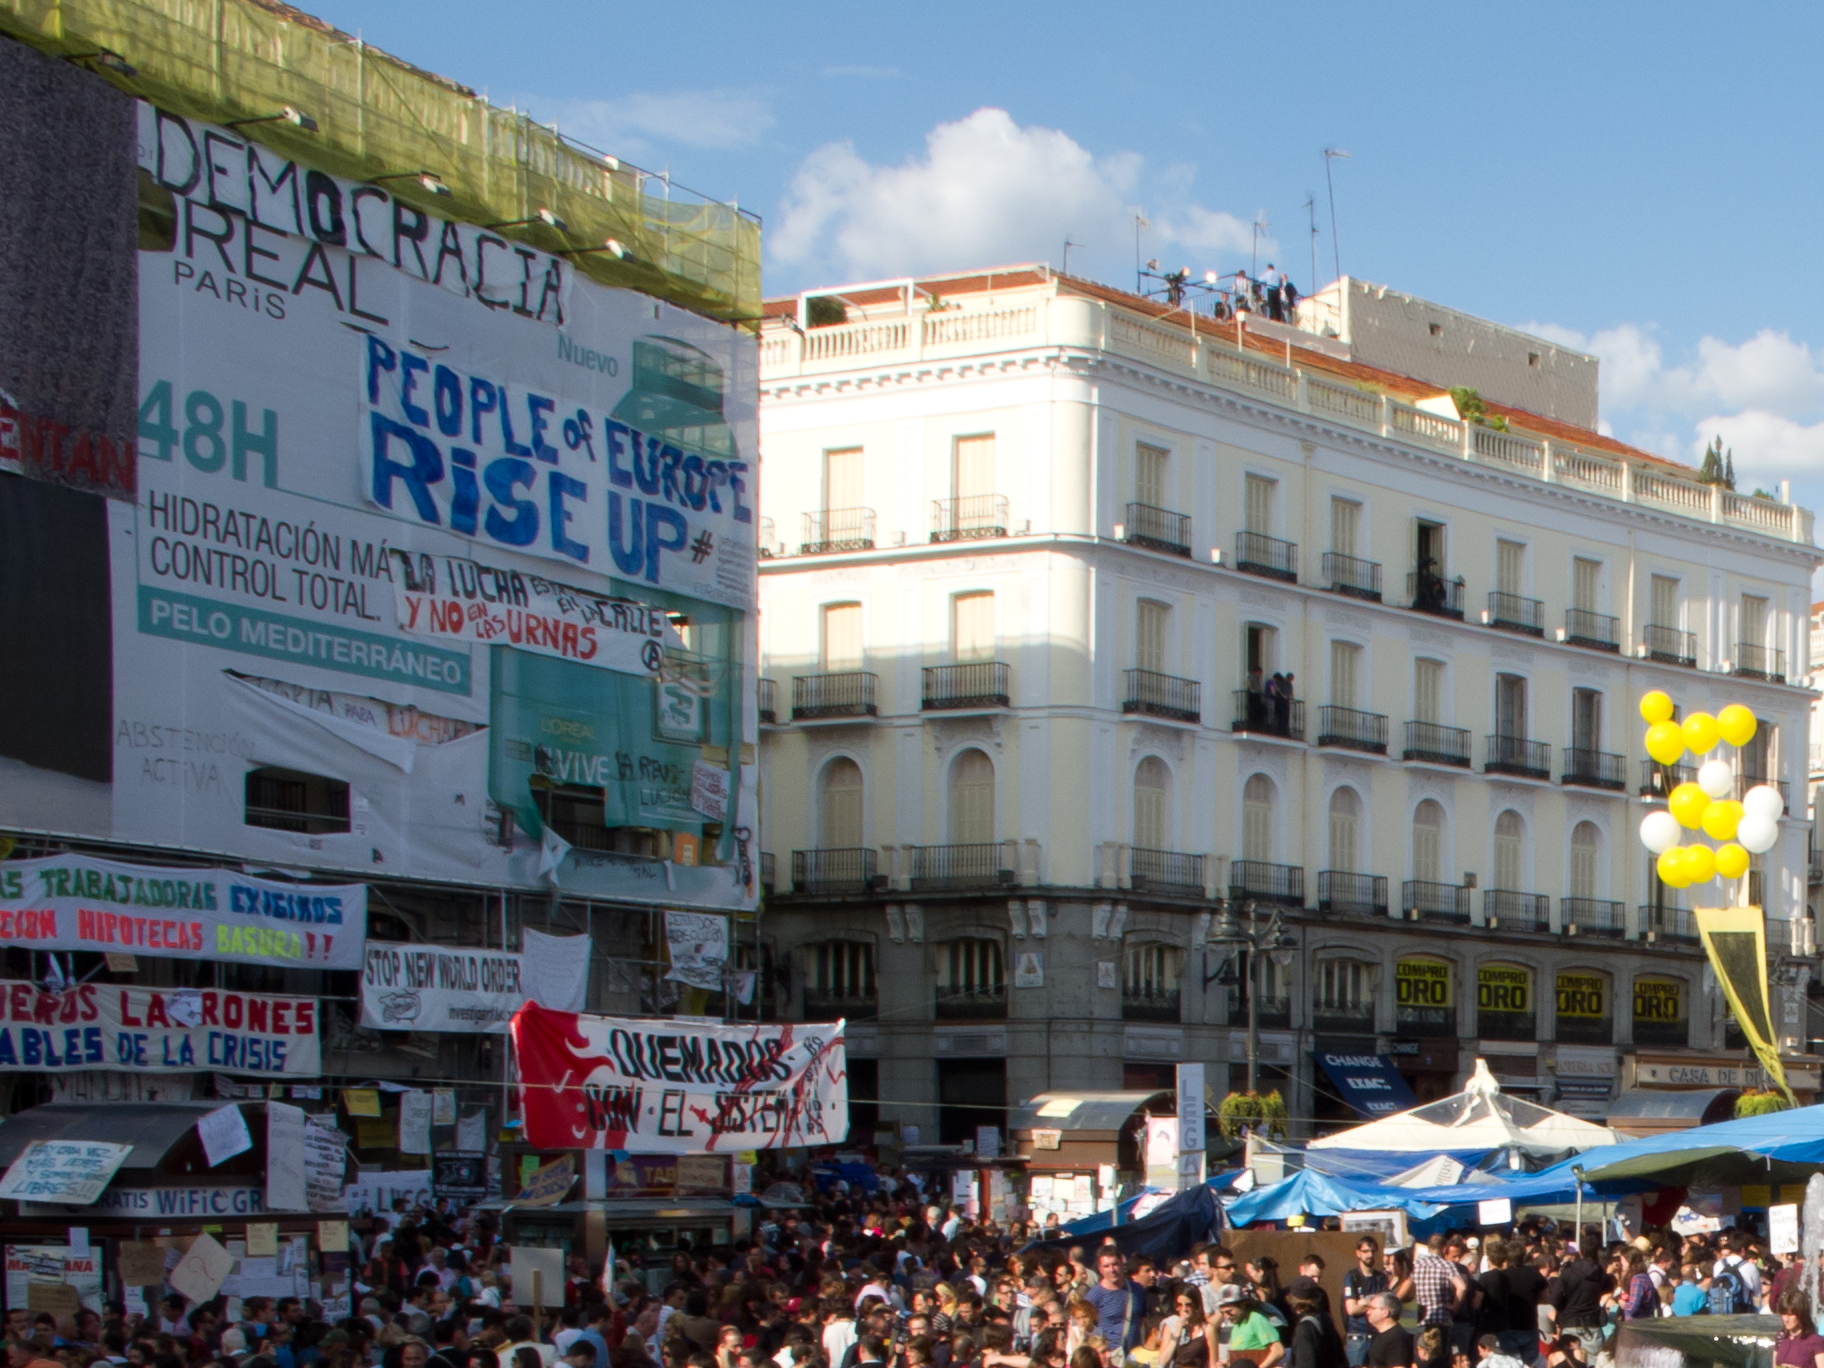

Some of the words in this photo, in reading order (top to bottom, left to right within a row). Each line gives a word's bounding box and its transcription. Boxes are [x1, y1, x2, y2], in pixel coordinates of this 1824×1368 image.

[155, 105, 565, 327] DEMOCRACIA
[184, 198, 390, 327] REAL
[557, 334, 619, 378] Nuevo
[138, 379, 278, 488] 48H
[366, 334, 559, 465] PEOPLE
[563, 408, 596, 463] of
[605, 417, 752, 524] EUROPE
[149, 490, 341, 570] HIDRATACIÓN
[607, 490, 688, 585] UP
[151, 537, 287, 602] CONTROL
[292, 568, 381, 621] TOTAL.
[402, 551, 436, 595] LA
[447, 559, 530, 608] LUCHA
[596, 601, 664, 638] CALLE
[151, 599, 231, 640] PELO
[240, 618, 461, 687] MEDITERRÁNEO
[405, 595, 423, 630] Y
[429, 600, 465, 634] NO
[475, 615, 506, 640] LAS
[507, 608, 598, 660] URNAS
[39, 867, 219, 911] TRABAJADORAS
[77, 908, 203, 951] HIPOTECAS
[366, 949, 400, 987] STOP
[404, 951, 436, 989] NEW
[437, 953, 478, 991] WORLD
[481, 956, 523, 994] ORDER
[1397, 978, 1447, 1005] ORO
[119, 990, 315, 1035] LARONES
[1478, 983, 1527, 1010] ORO
[1556, 989, 1603, 1015] ORO
[1633, 994, 1679, 1020] ORO
[116, 1031, 149, 1066] DE
[162, 1034, 195, 1067] LA
[207, 1031, 287, 1073] CRISIS
[610, 1029, 792, 1084] QUEMADOS
[1325, 1054, 1384, 1068] CHANGE
[1669, 1067, 1710, 1084] CASA
[1717, 1067, 1737, 1084] DE
[584, 1083, 643, 1134] CON
[658, 1089, 694, 1137] EL
